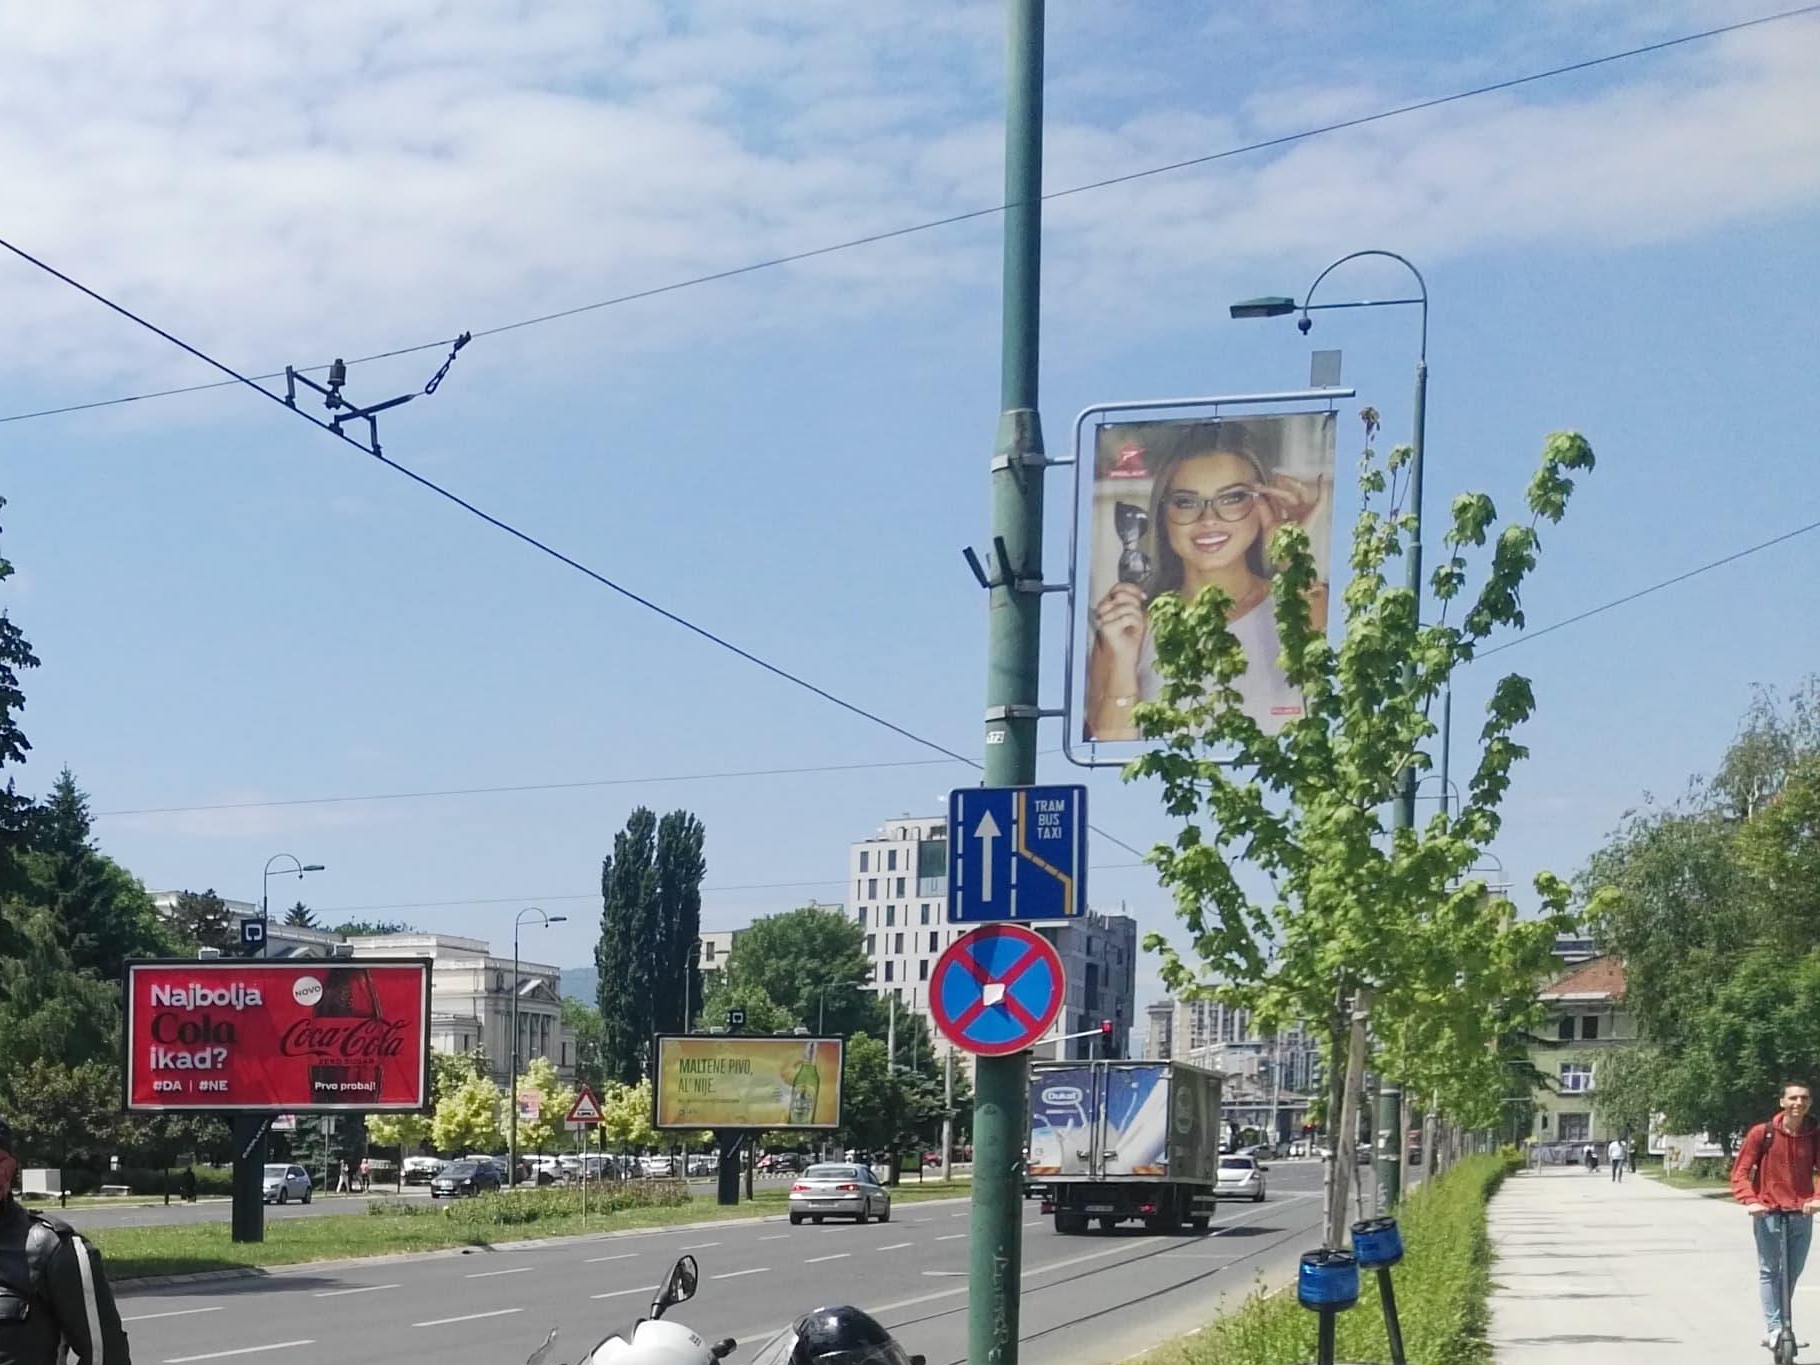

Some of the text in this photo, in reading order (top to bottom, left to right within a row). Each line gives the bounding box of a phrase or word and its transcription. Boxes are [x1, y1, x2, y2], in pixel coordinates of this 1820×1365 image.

[1035, 800, 1065, 812] TRAM
[1038, 814, 1061, 826] BUS
[1037, 827, 1062, 839] TAXI
[150, 983, 262, 1010] Najbolja
[295, 985, 321, 997] NOVO
[151, 1012, 237, 1046] Cola
[279, 1018, 414, 1058] Coca-Cola
[150, 1047, 228, 1070] ikad?
[679, 1058, 725, 1074] MALTENE
[152, 1080, 228, 1092] #DA #NE
[314, 1081, 376, 1092] Prvo probaj!
